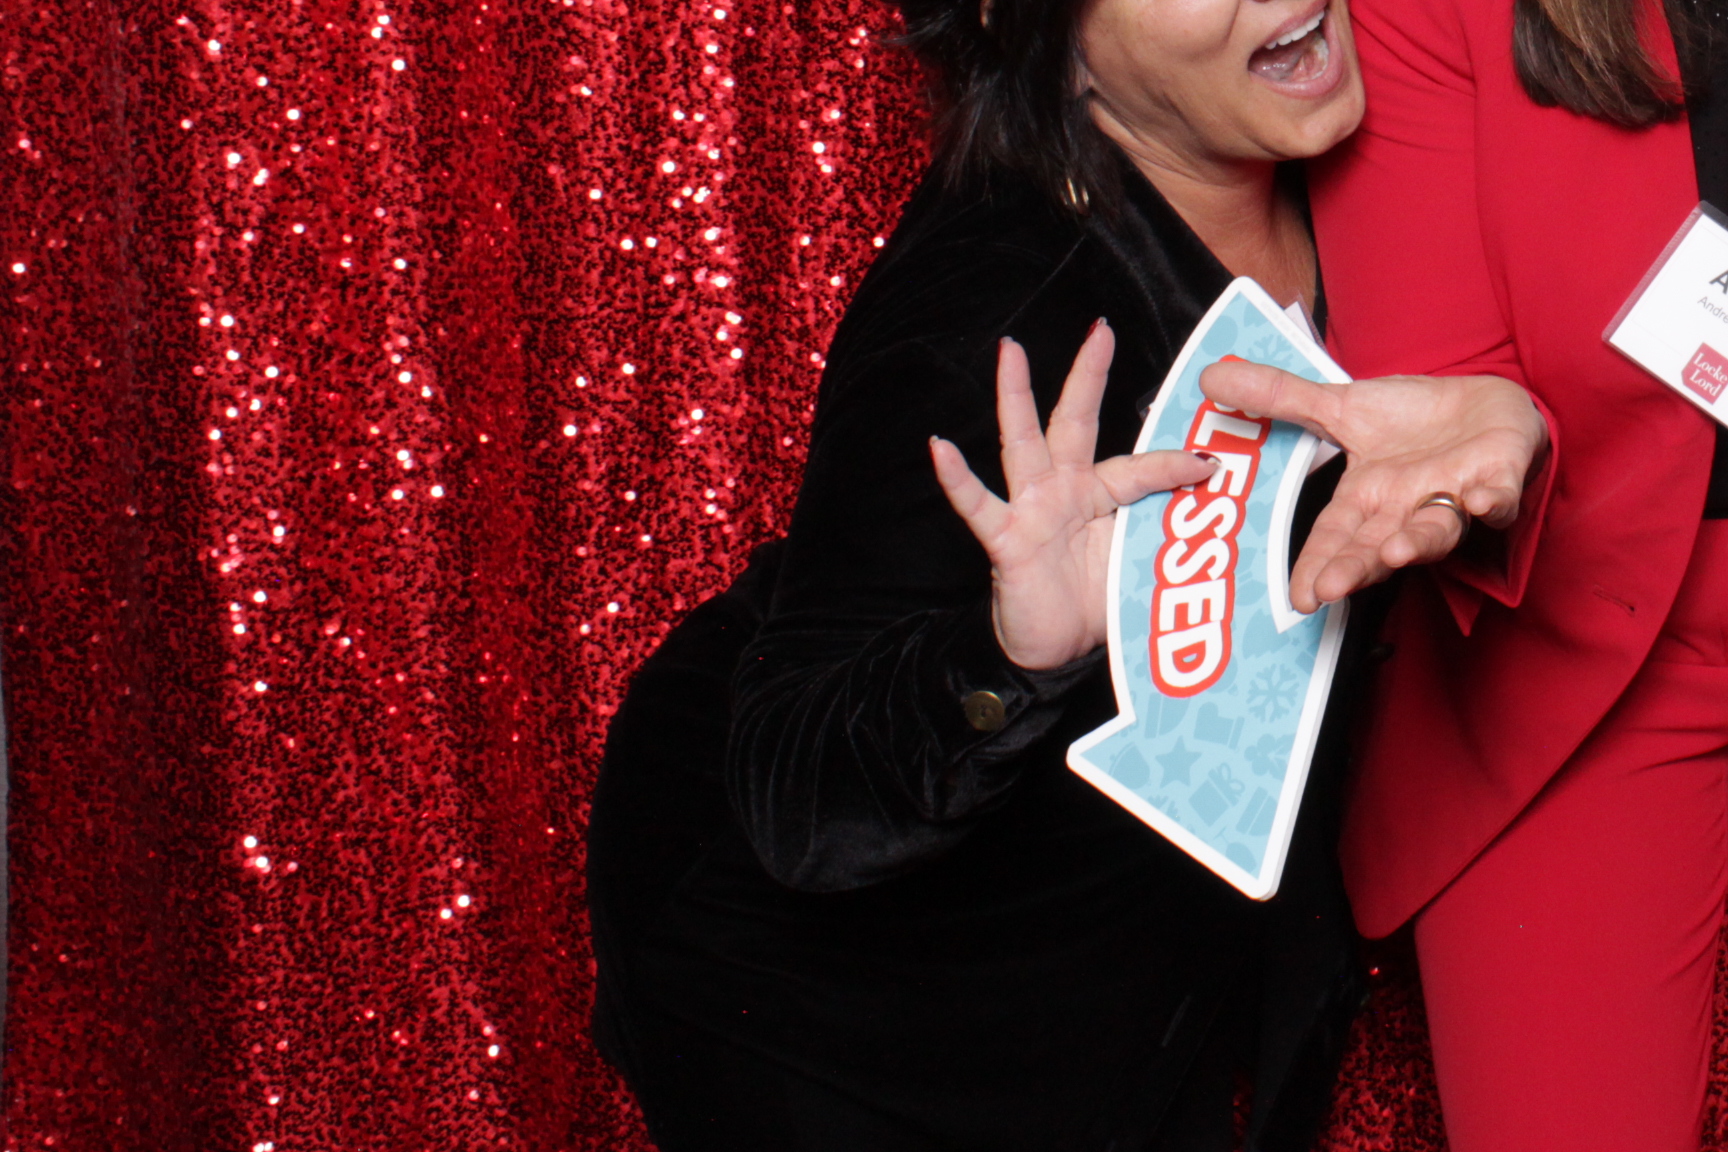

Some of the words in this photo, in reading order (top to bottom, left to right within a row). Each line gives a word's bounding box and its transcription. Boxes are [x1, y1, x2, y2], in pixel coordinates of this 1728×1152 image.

[1689, 369, 1722, 397] Lord
[1692, 352, 1728, 384] Locke
[1156, 401, 1264, 690] LESSED
